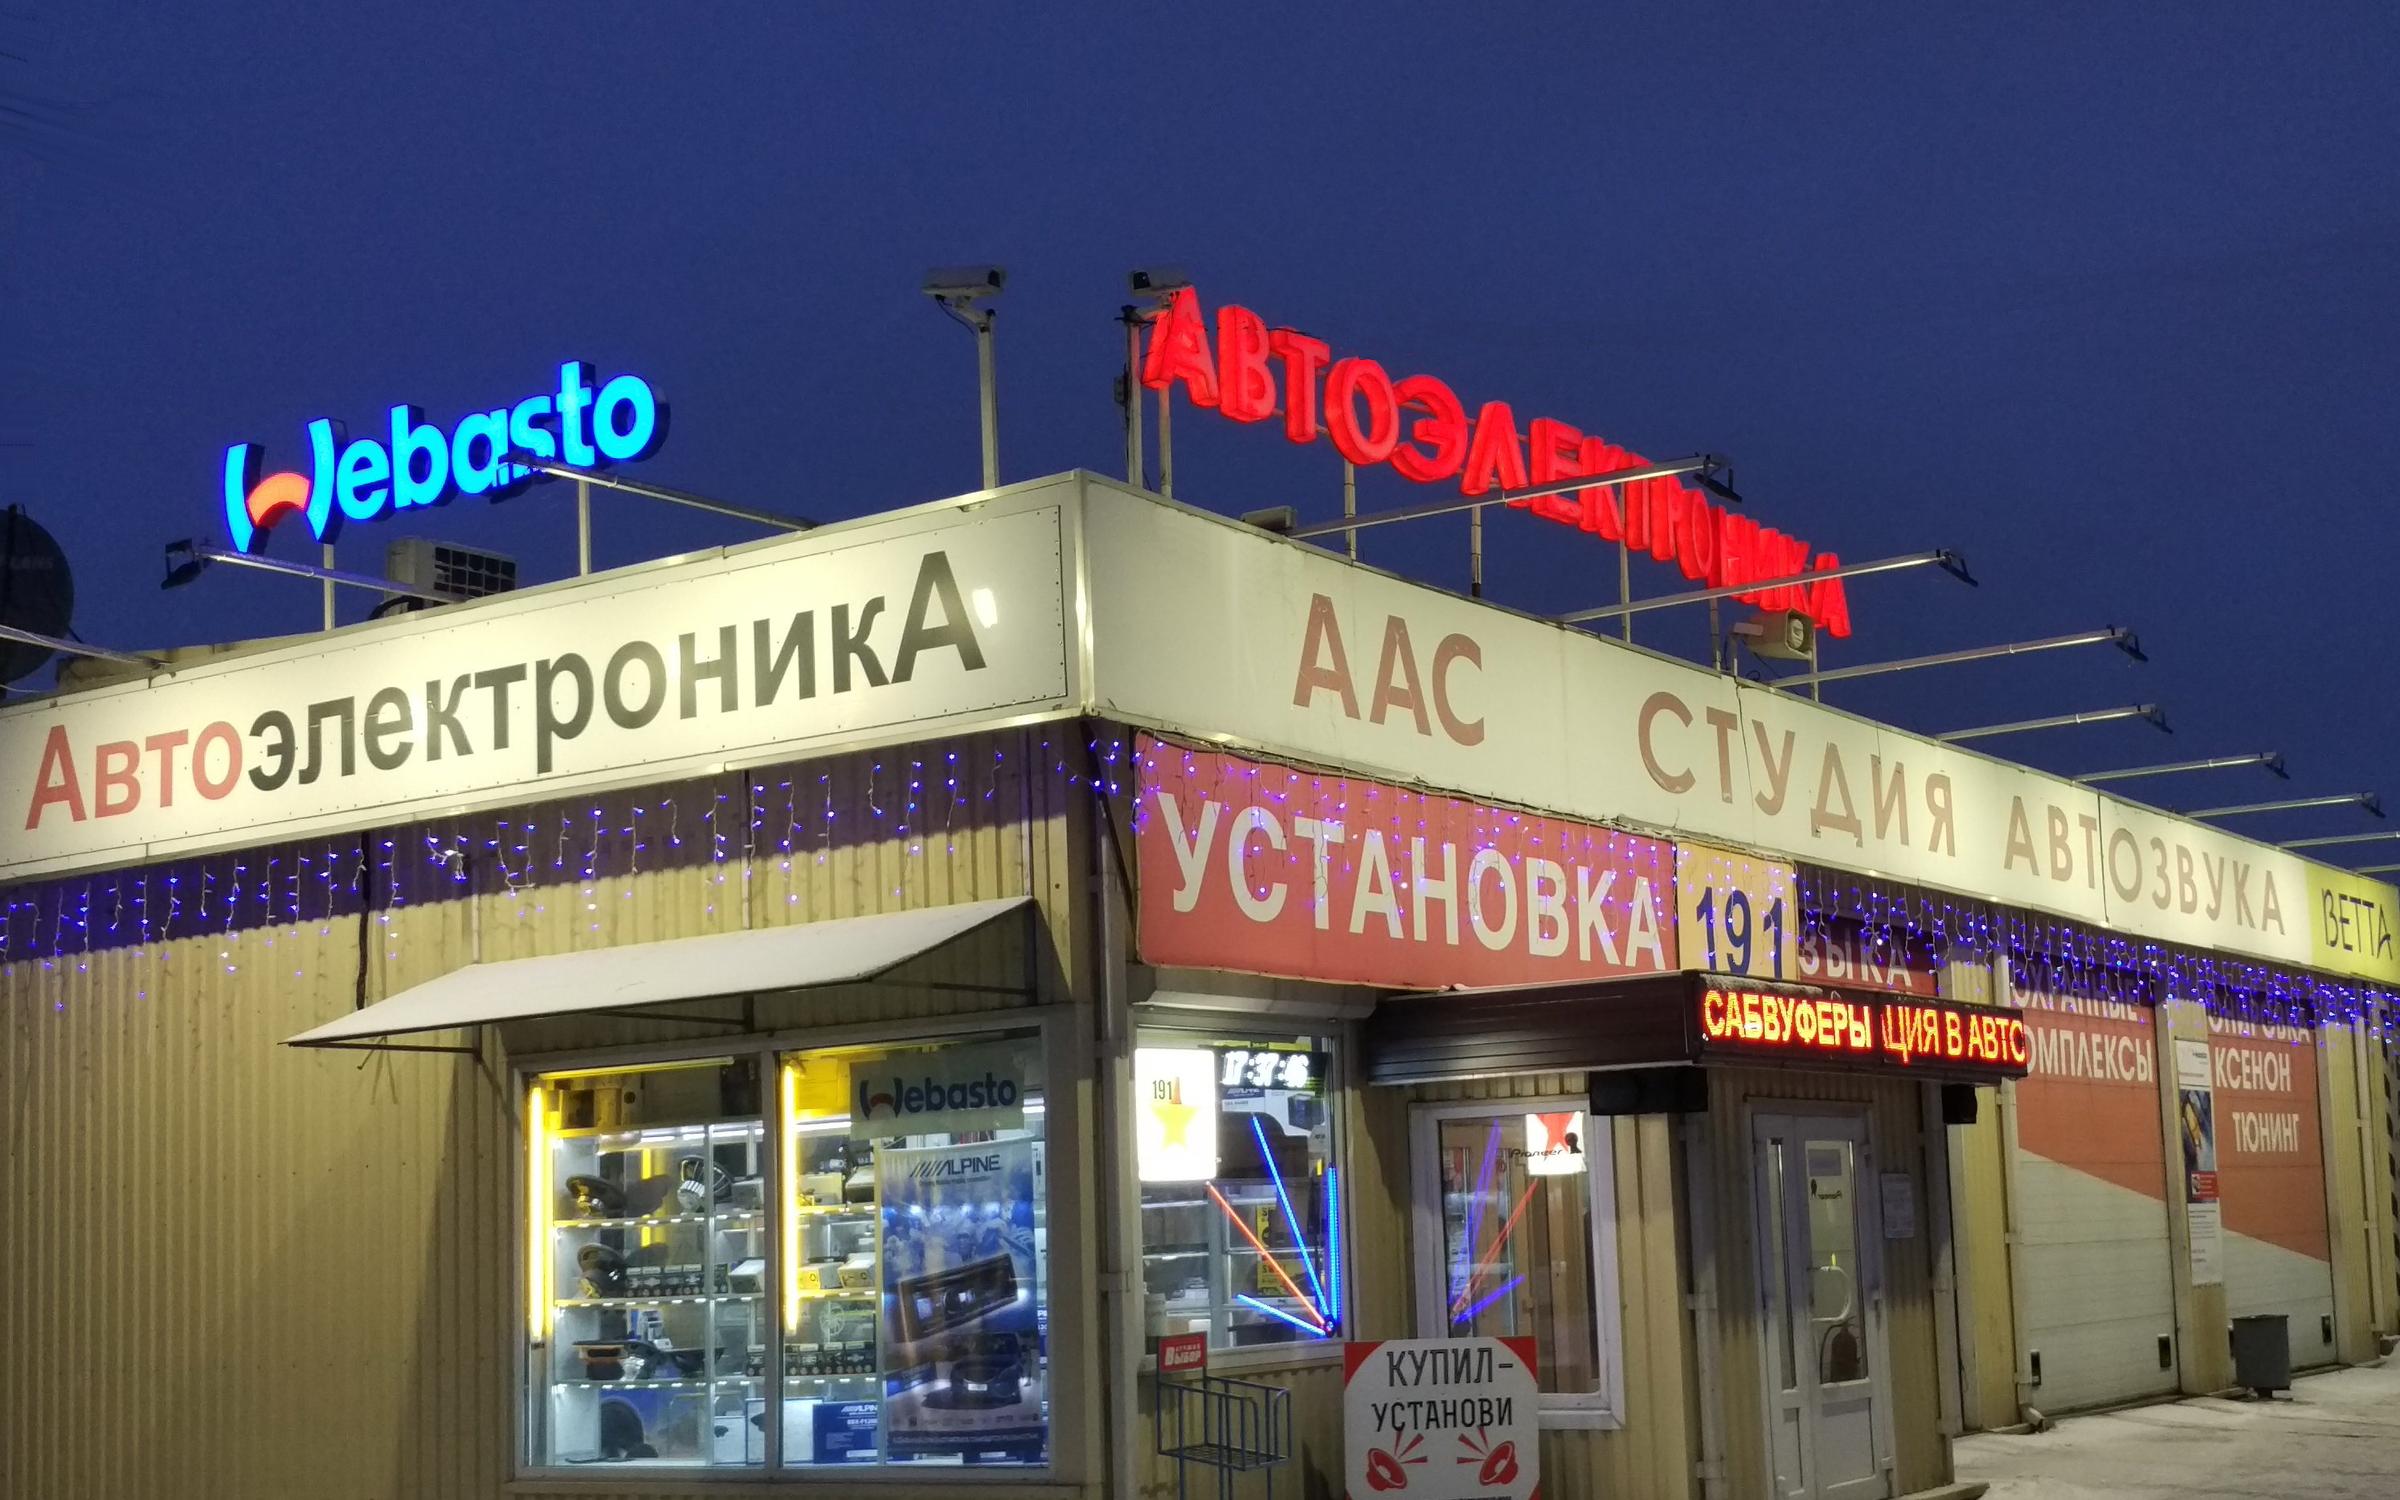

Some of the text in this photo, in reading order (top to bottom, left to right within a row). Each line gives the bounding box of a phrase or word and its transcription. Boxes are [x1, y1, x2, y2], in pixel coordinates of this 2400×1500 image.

[224, 359, 660, 554] Webasto
[1142, 285, 1852, 638] АВТОЭЛЕКТРОНИКА
[1293, 592, 2286, 935] ААС СТУДИЯ АВТОЗВУКА
[1156, 791, 1667, 970] УСТАНОВКА
[1696, 885, 1784, 980] 191
[1799, 920, 1913, 988] ЗЫКА
[1704, 990, 1873, 1048] САБВУФЕРЫ
[1945, 1010, 1963, 1057] В
[2024, 1024, 2154, 1084] ОМПЛЕКСЫ
[859, 1071, 1018, 1121] Webasto
[2215, 1046, 2292, 1092] КСЕНОН
[932, 1154, 1004, 1176] ALPINE
[2232, 1110, 2300, 1153] ТЮНИНГ
[1371, 1396, 1514, 1433] УСТАНОВИ
